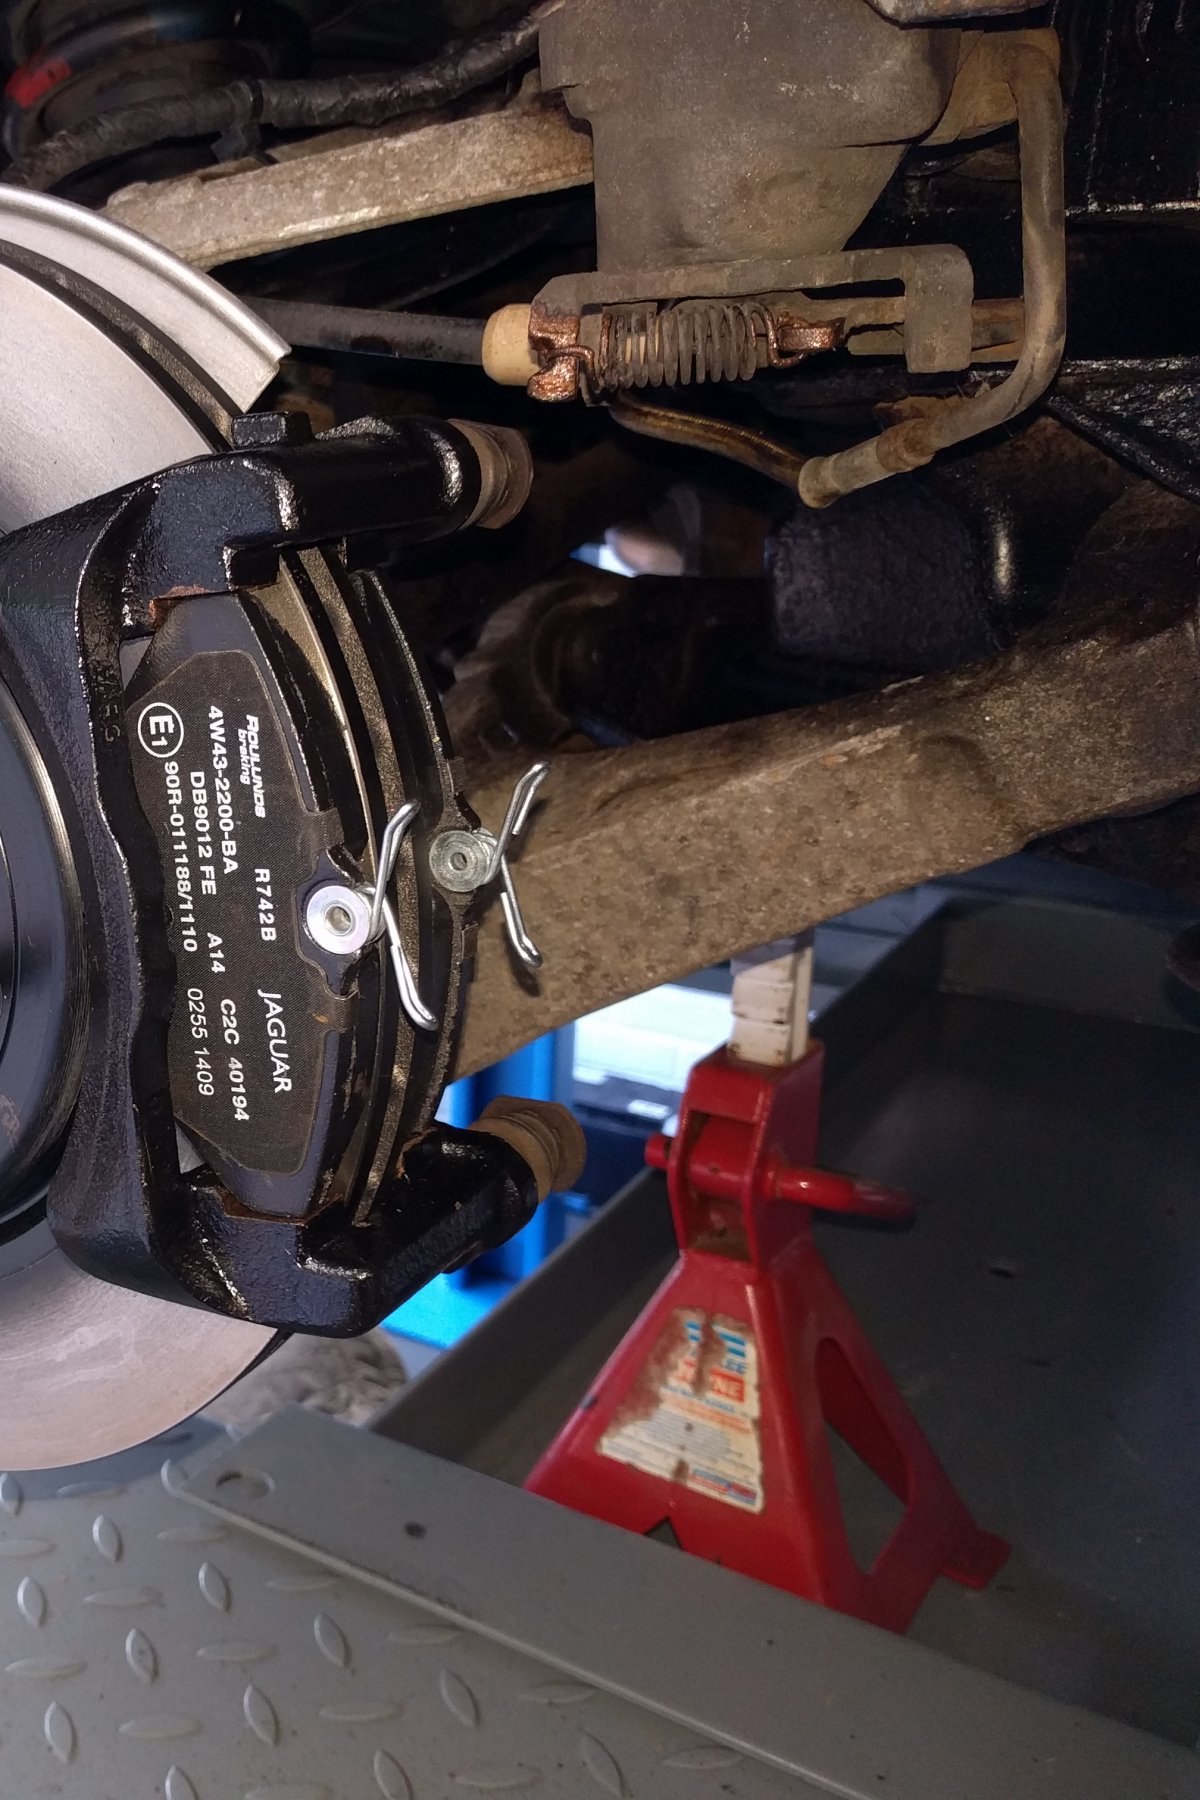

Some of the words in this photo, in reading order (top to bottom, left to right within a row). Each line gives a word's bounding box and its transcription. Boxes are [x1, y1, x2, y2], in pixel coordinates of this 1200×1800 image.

[237, 728, 251, 786] braking
[245, 714, 266, 819] ROULUNDS
[189, 770, 213, 859] DB9012
[208, 705, 239, 875] 4W43-2200-BA
[164, 760, 198, 953] 90R-011188/1110
[199, 865, 217, 896] FE
[254, 868, 278, 942] R742B
[206, 932, 226, 974] A14
[187, 987, 209, 1039] 0255
[220, 998, 241, 1045] C2C
[257, 988, 293, 1094] JAGUAR
[194, 1047, 215, 1096] 1409
[227, 1056, 250, 1121] 40194
